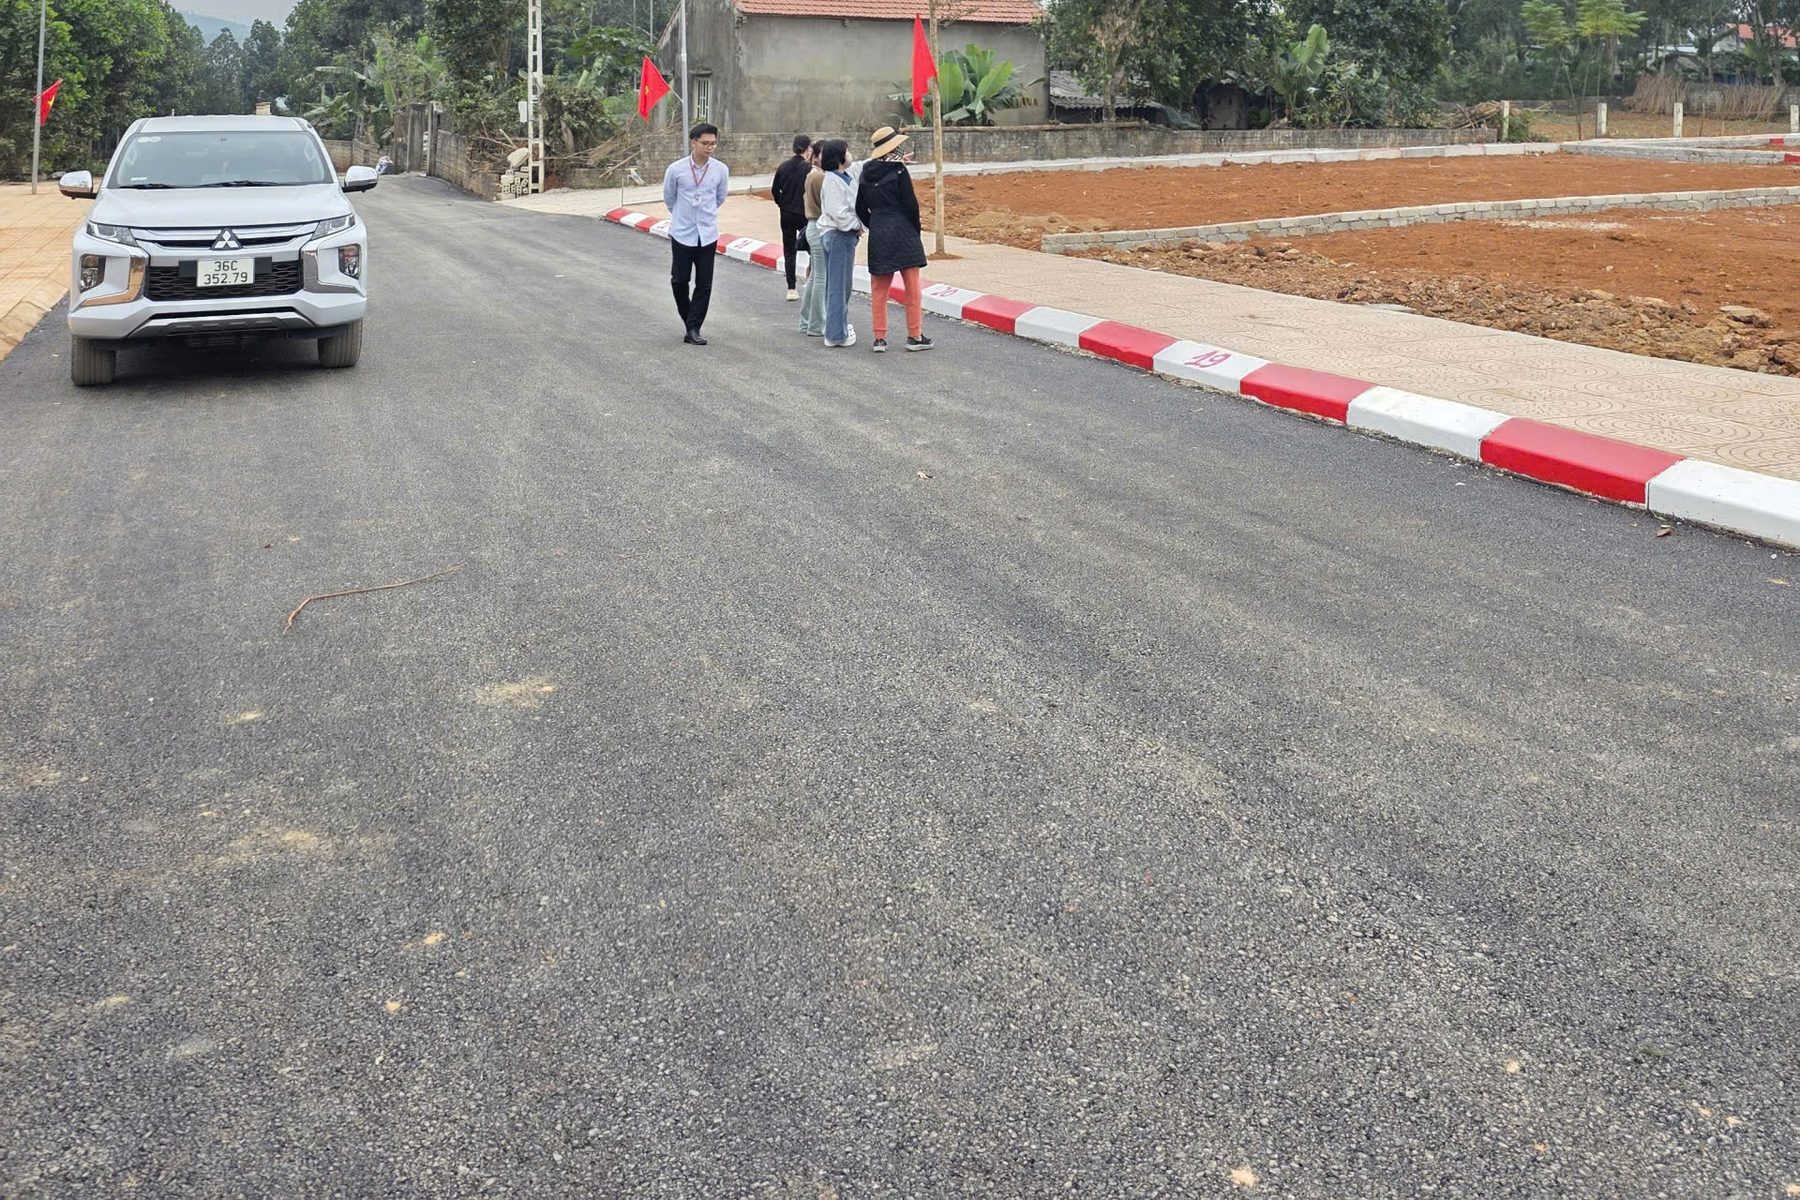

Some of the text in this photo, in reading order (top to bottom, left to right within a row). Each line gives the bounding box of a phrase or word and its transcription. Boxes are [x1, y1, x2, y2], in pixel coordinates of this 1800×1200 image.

[214, 260, 238, 272] 36C
[203, 272, 248, 285] 352.79
[1184, 350, 1232, 368] 19
